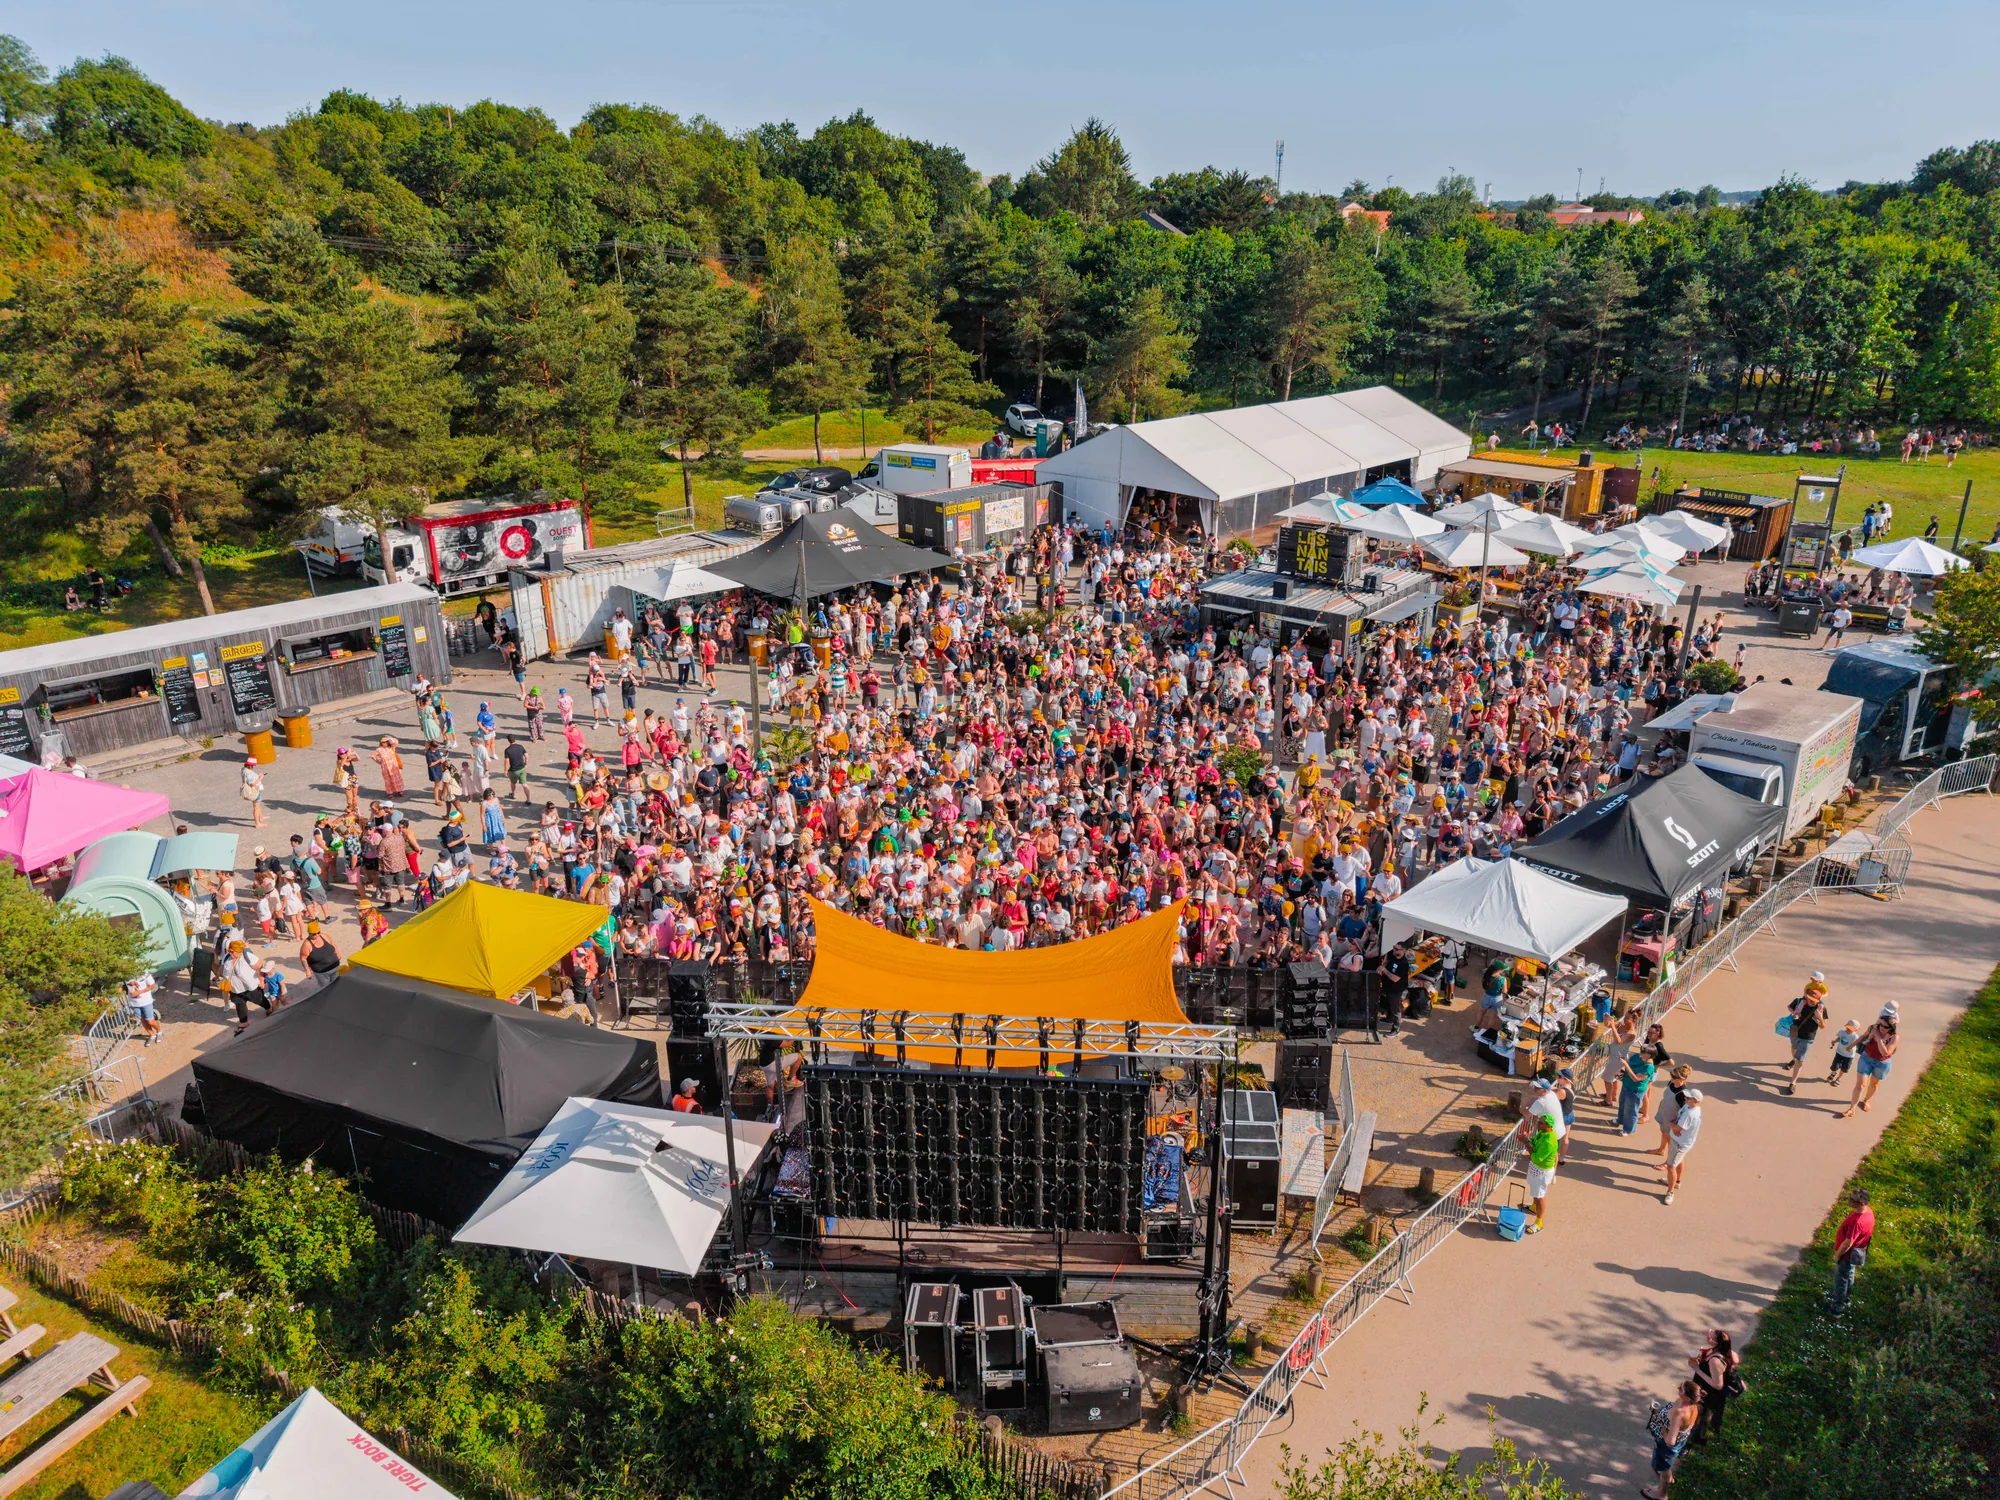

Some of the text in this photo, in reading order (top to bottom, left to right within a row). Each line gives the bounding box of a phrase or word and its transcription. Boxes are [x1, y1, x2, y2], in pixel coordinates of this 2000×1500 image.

[549, 525, 577, 537] OUEST
[1296, 544, 1329, 561] NAN
[1296, 557, 1328, 574] TAIS
[221, 643, 263, 659] BURGERS
[1710, 732, 1778, 752] Cuisine Itinérante
[1595, 793, 1629, 816] SCOTT
[1686, 839, 1720, 869] SCOTT
[1740, 835, 1759, 856] SCOTT
[1529, 864, 1580, 881] SCOTT
[1679, 882, 1702, 903] SCOTT
[536, 1141, 569, 1172] 1664
[684, 1157, 715, 1195] 1664
[701, 1166, 728, 1198] BLANC
[346, 1433, 428, 1493] TIGRE BOCK
